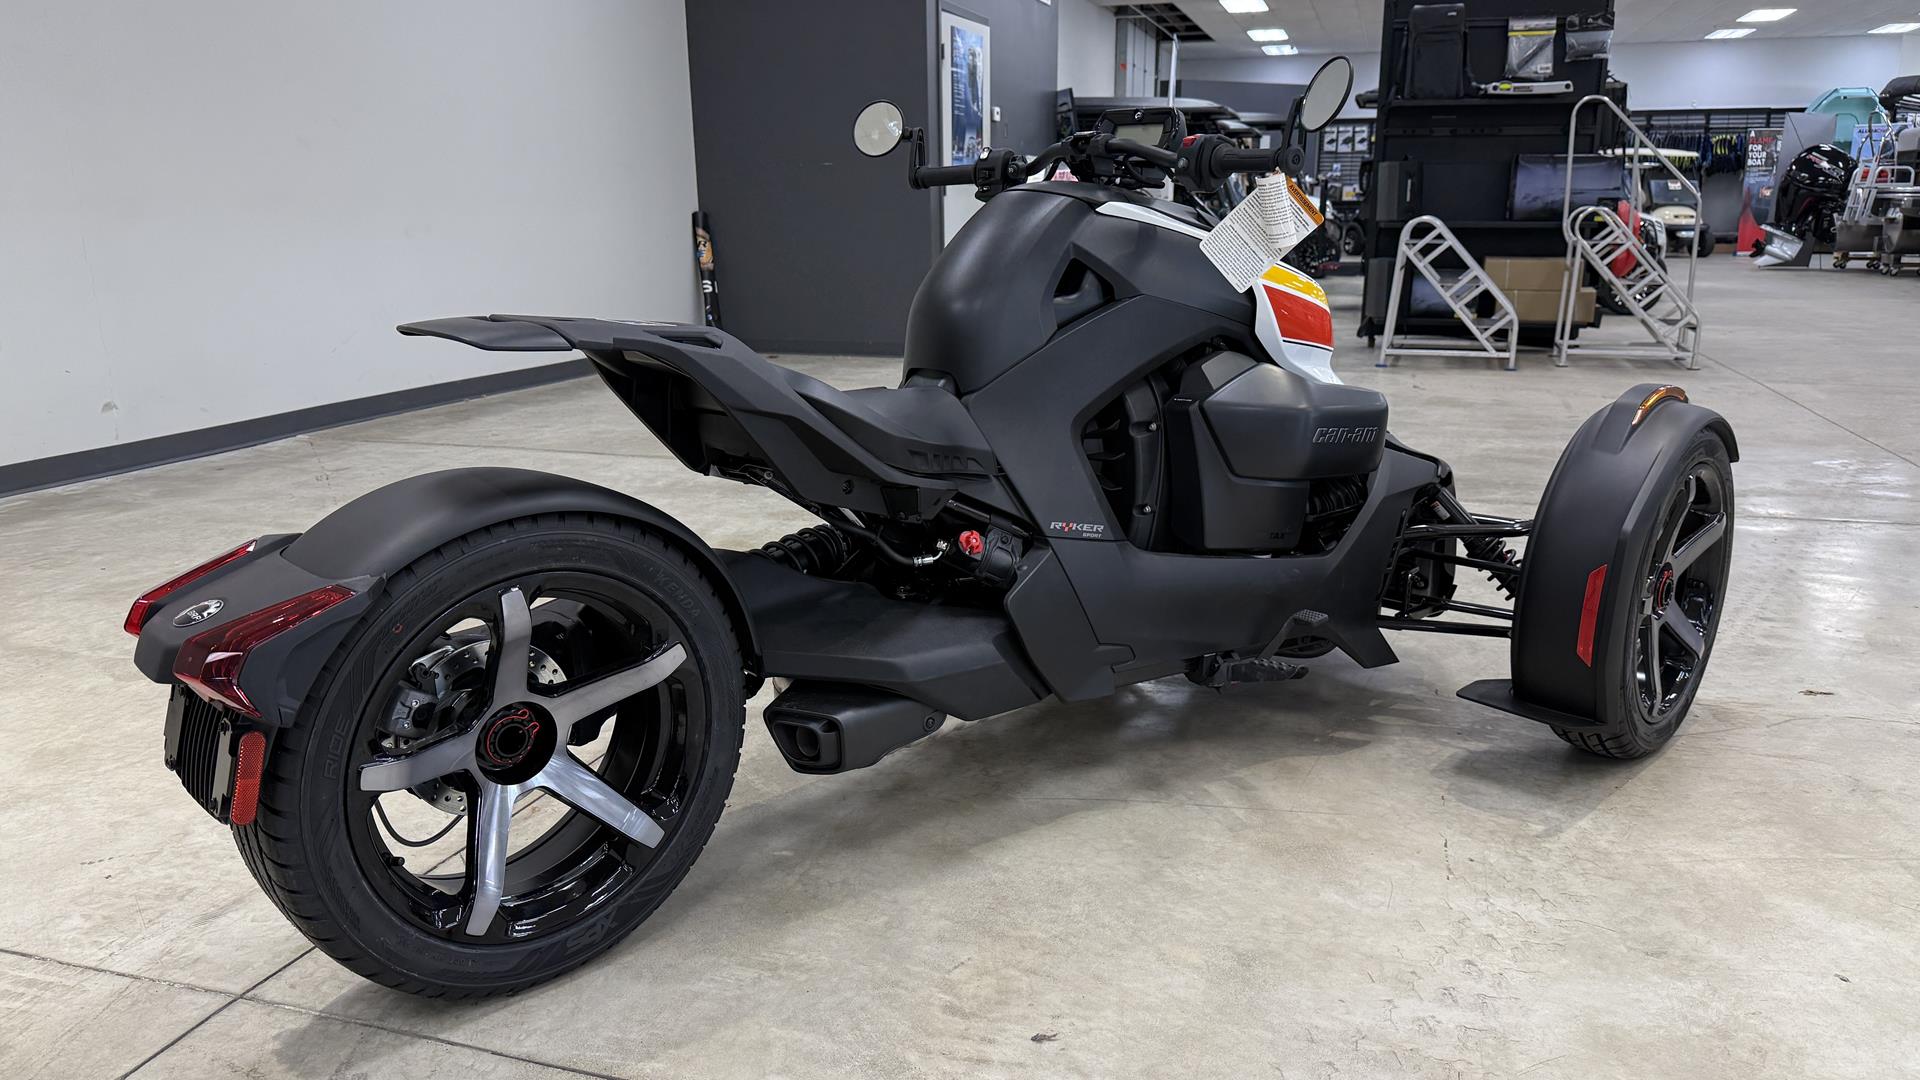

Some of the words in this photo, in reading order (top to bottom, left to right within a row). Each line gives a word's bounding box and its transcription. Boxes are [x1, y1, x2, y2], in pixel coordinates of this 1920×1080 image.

[1748, 144, 1763, 152] FOR
[1748, 151, 1767, 159] YOUR
[1747, 158, 1766, 166] BOAT
[1050, 520, 1105, 533] RYKER
[324, 712, 351, 780] RIDE
